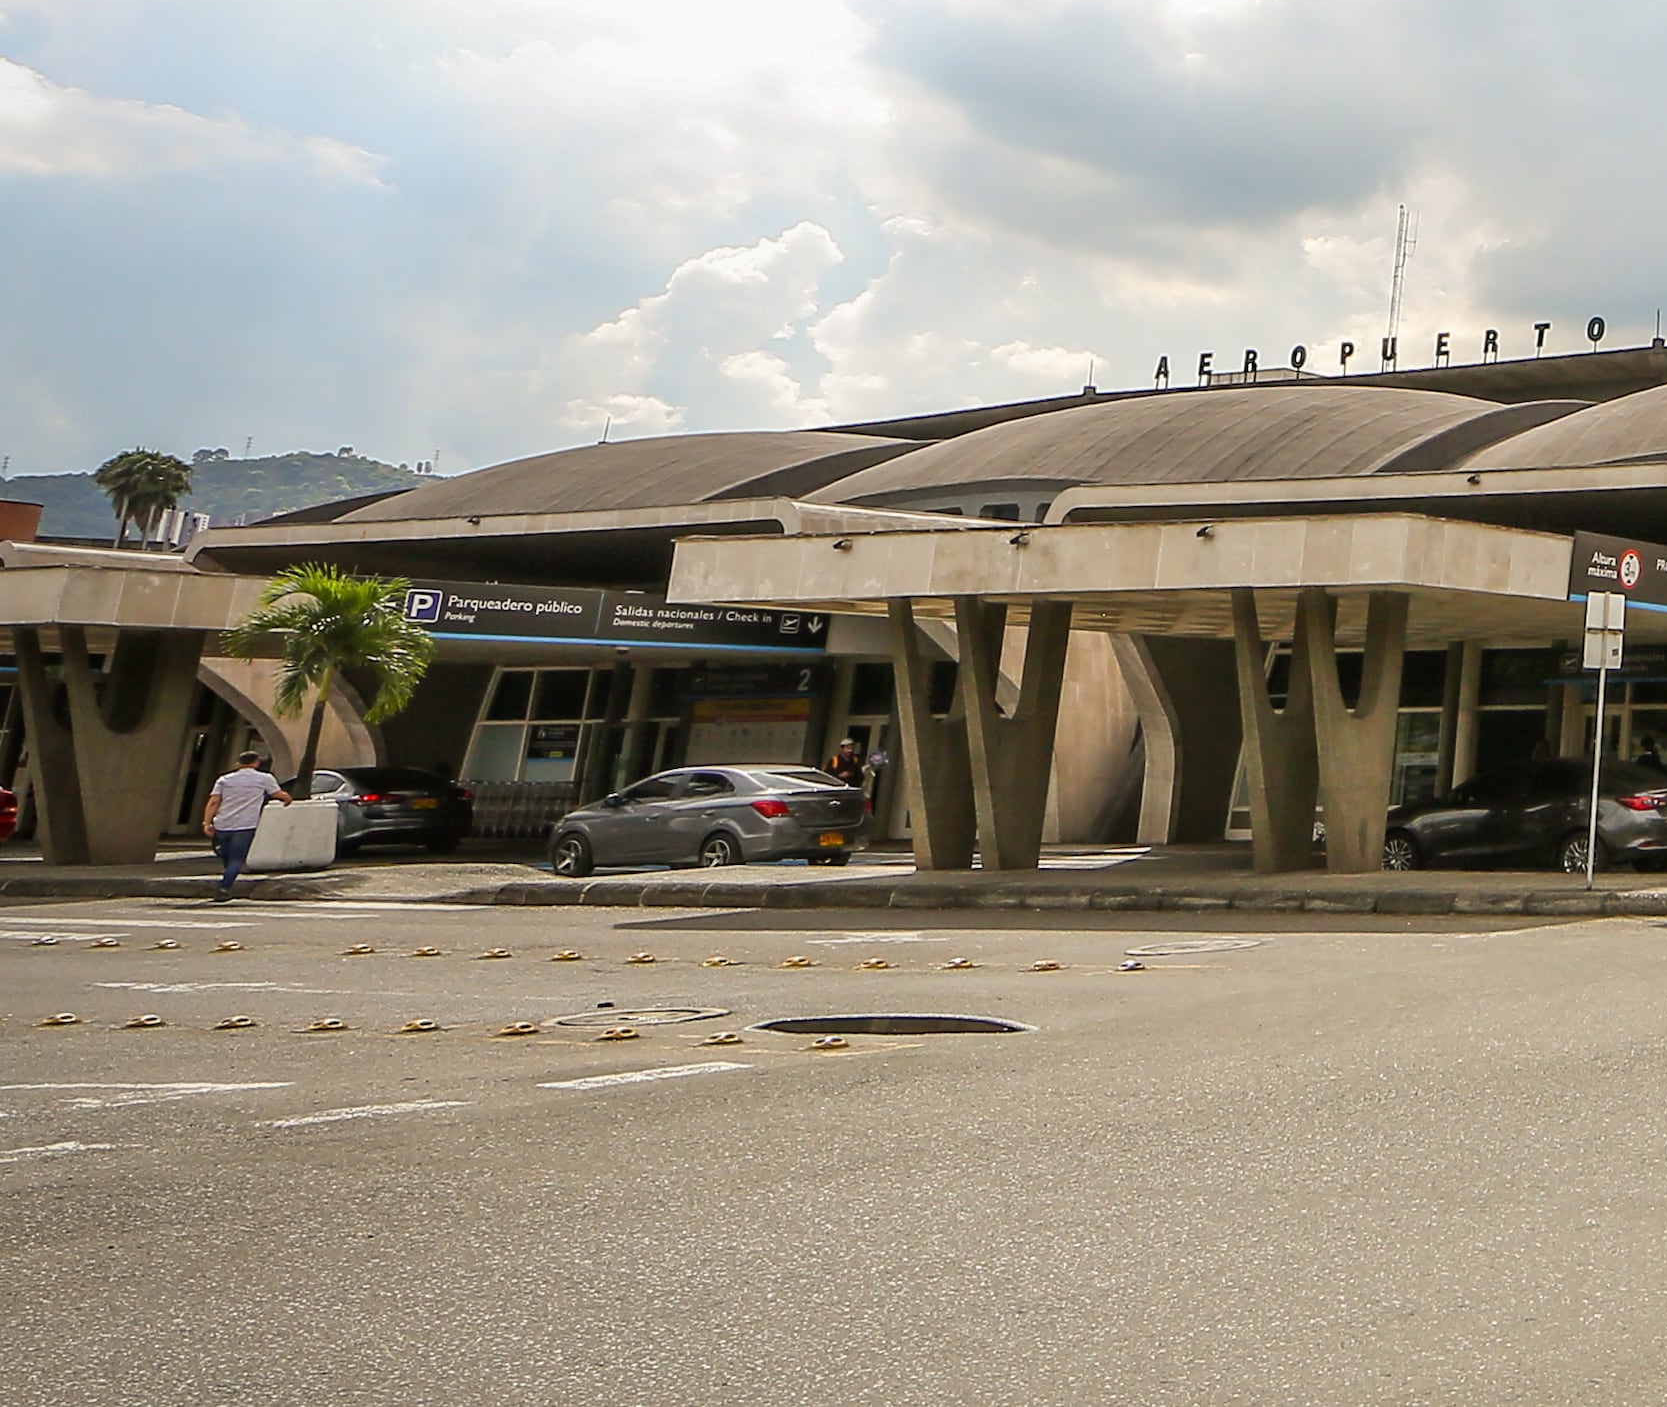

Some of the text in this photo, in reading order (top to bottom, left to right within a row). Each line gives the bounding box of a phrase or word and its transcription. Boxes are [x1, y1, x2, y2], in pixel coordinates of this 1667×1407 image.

[1155, 316, 1606, 378] AEROPUERTO
[1591, 552, 1617, 567] Altura
[1587, 566, 1618, 580] máxima
[410, 594, 434, 618] P
[447, 595, 583, 615] Parqueadero público
[614, 604, 653, 618] Salidas
[657, 608, 714, 621] nacionales
[726, 610, 758, 623] Check
[762, 613, 772, 623] in
[444, 611, 477, 624] Parking
[612, 617, 694, 630] Domestic departures
[798, 669, 811, 691] 2
